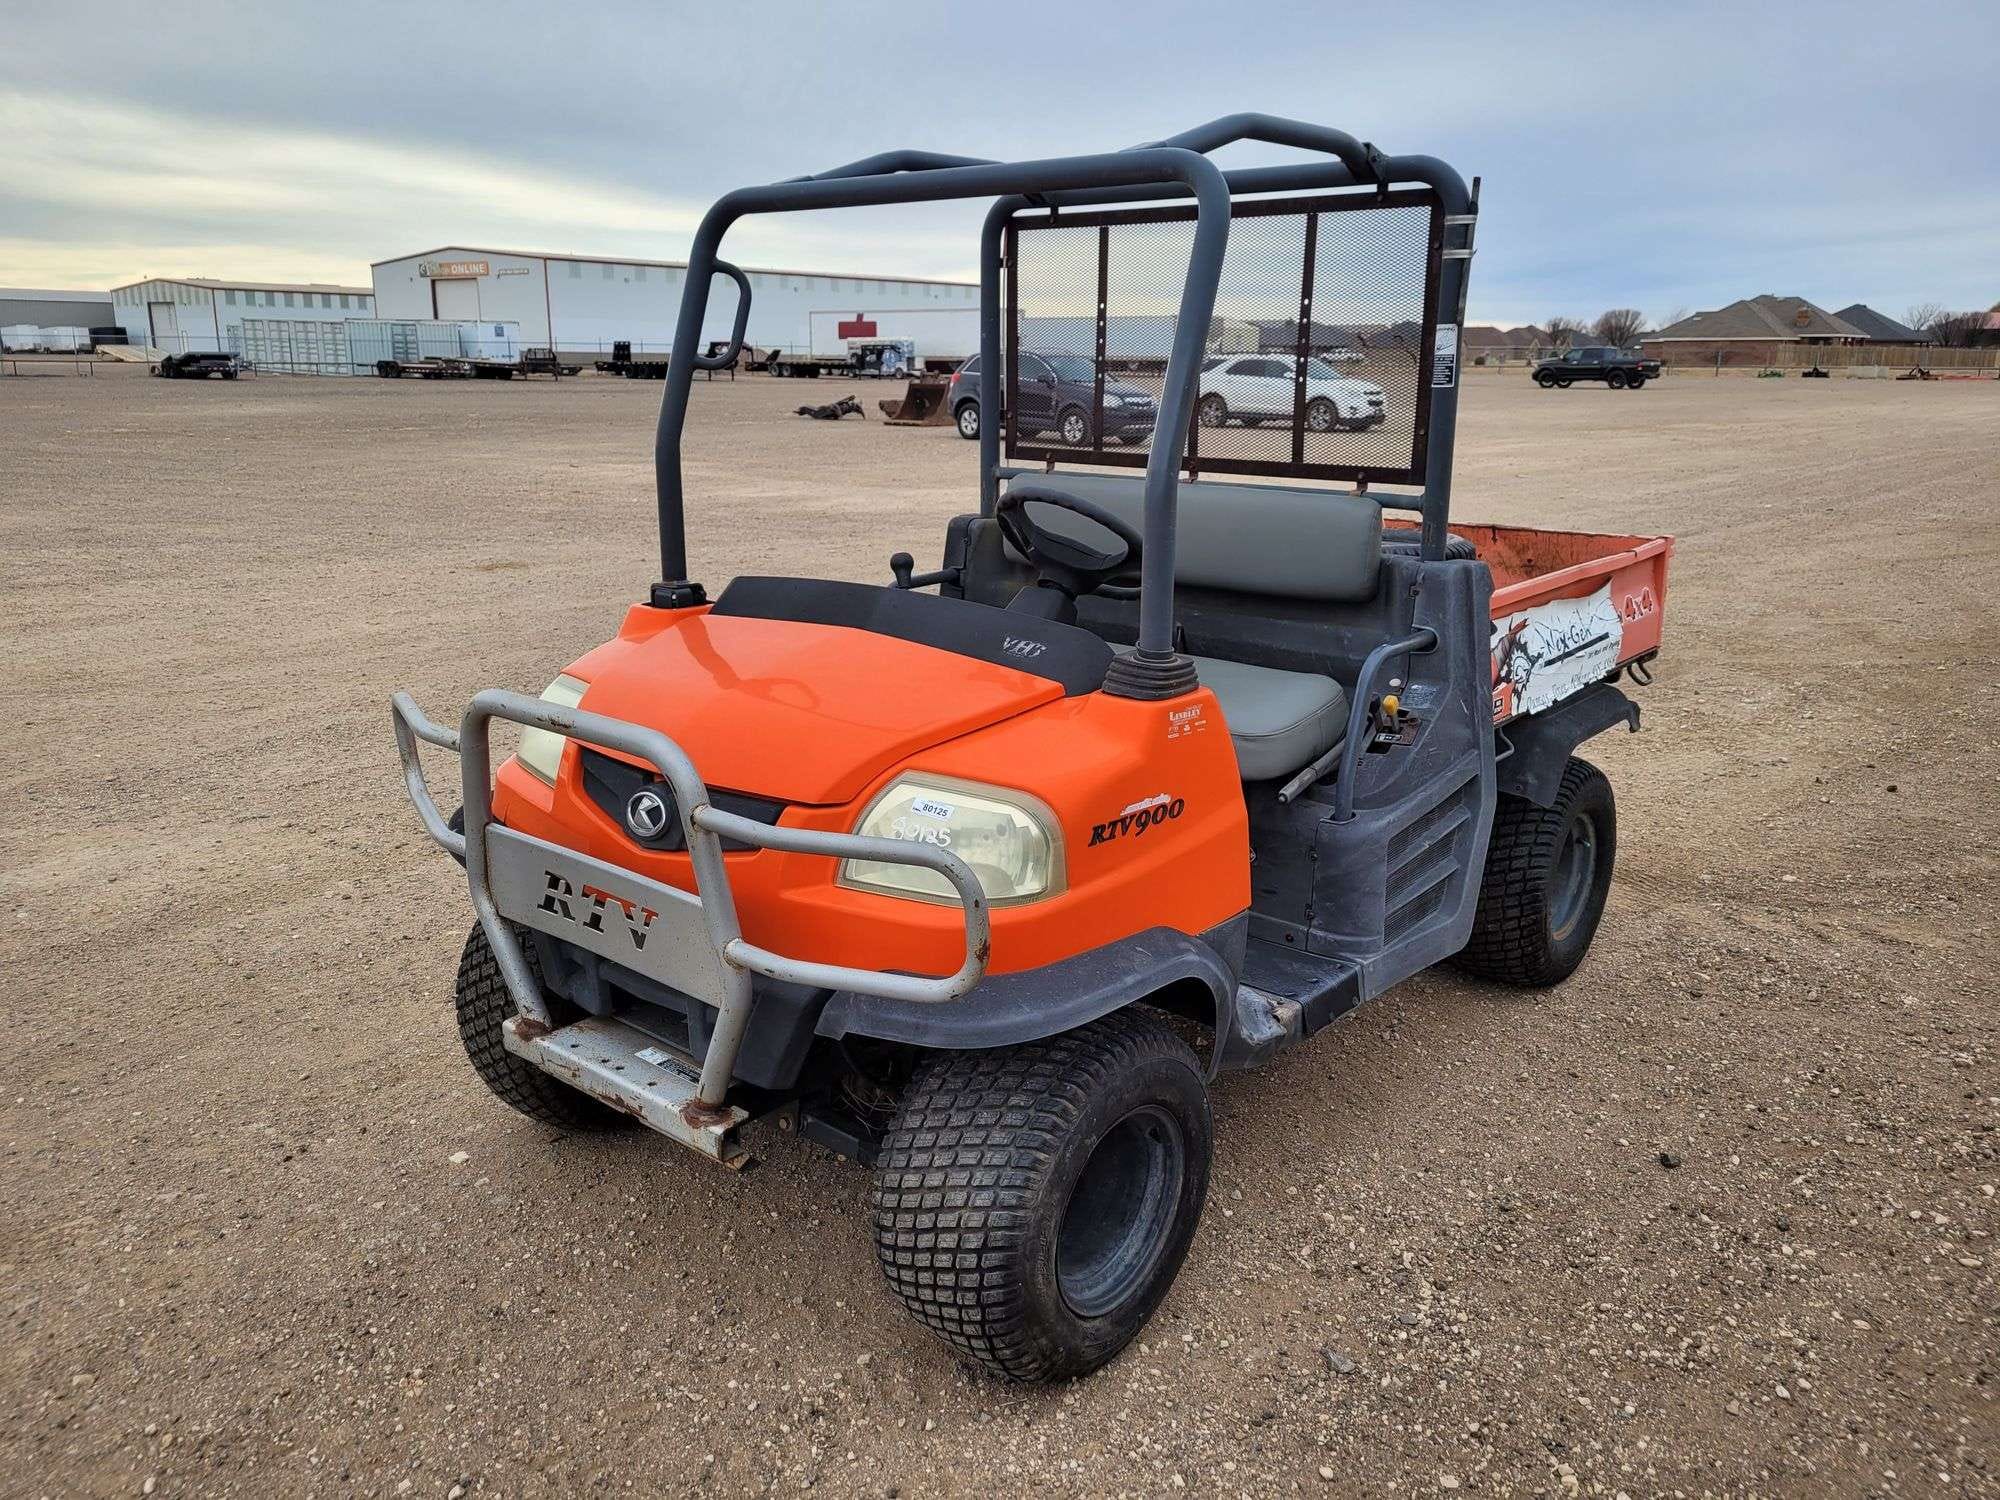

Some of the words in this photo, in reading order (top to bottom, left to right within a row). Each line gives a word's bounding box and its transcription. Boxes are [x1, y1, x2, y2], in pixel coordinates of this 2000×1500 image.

[451, 262, 486, 275] ONLINE
[922, 803, 949, 817] 80125
[1088, 798, 1185, 847] RTV900
[537, 870, 659, 951] RTV
